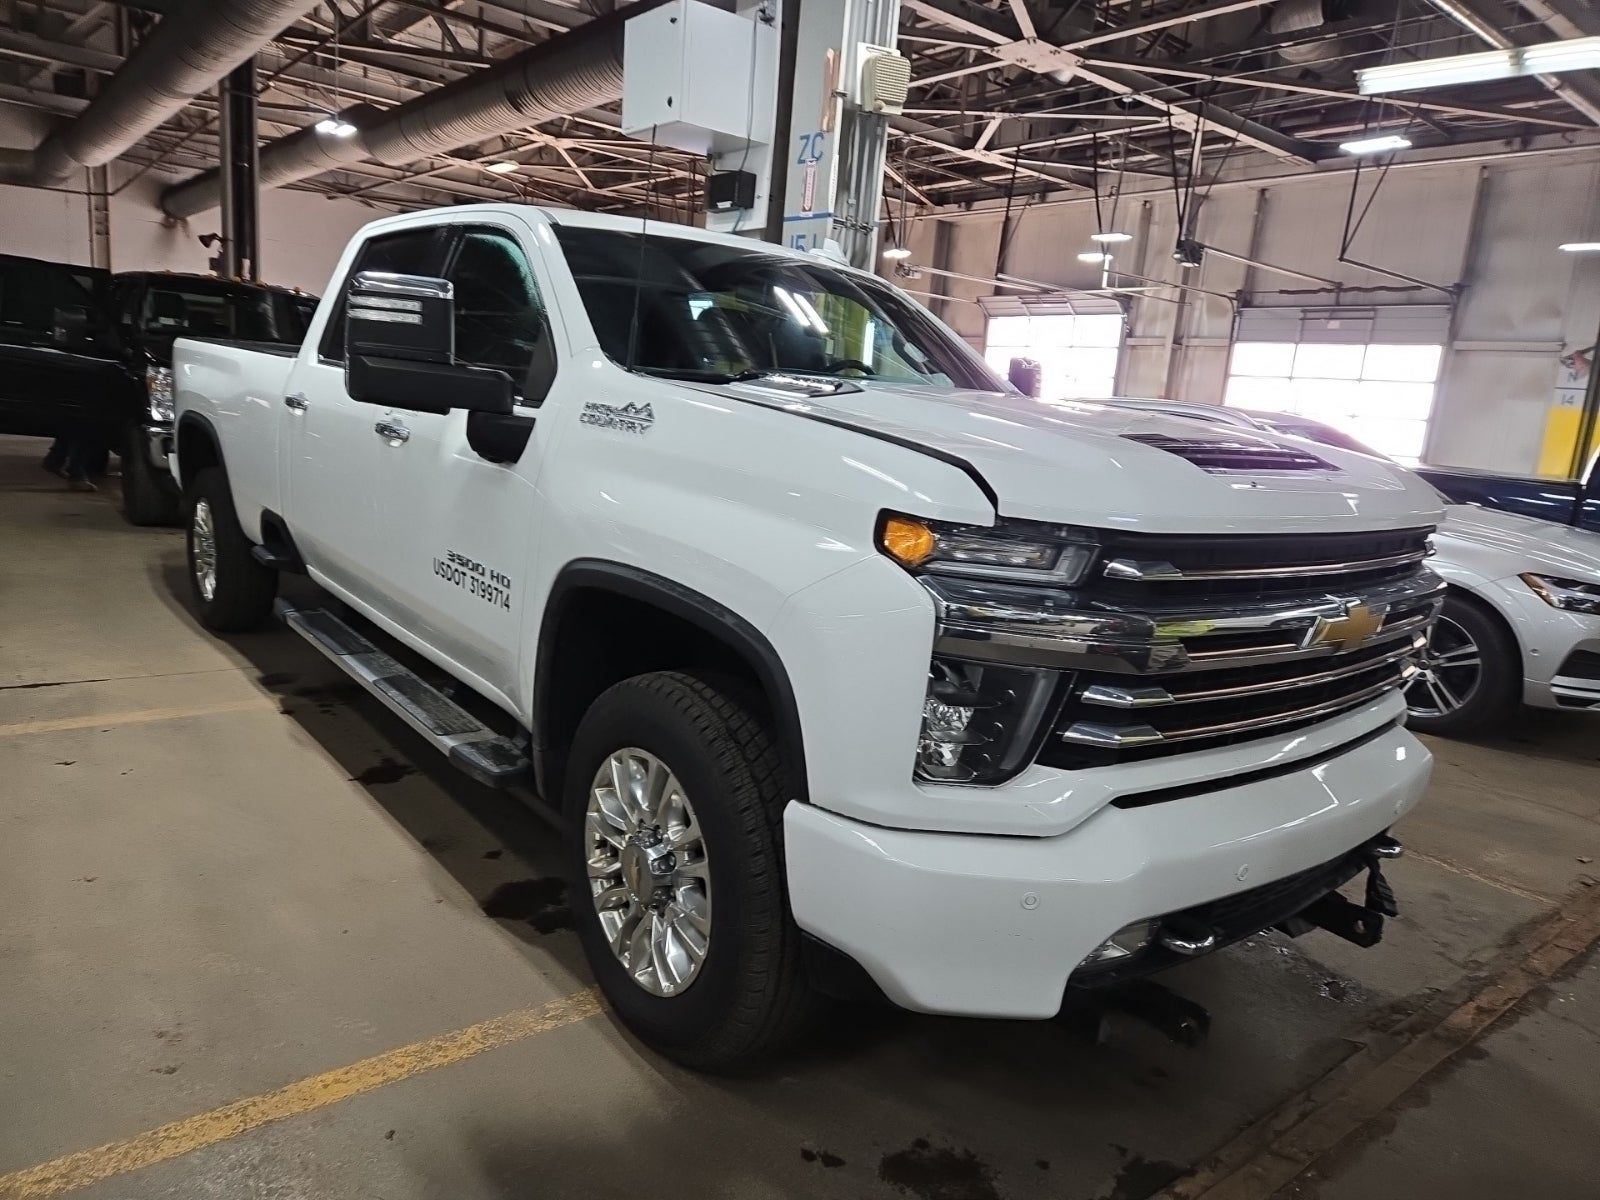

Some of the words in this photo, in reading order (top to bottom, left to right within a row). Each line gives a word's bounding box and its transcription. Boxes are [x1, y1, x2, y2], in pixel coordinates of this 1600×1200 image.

[797, 132, 824, 164] ZC
[433, 557, 467, 590] USDOT
[470, 575, 510, 613] 3199714
[446, 549, 485, 577] 3500
[490, 569, 511, 589] HD
